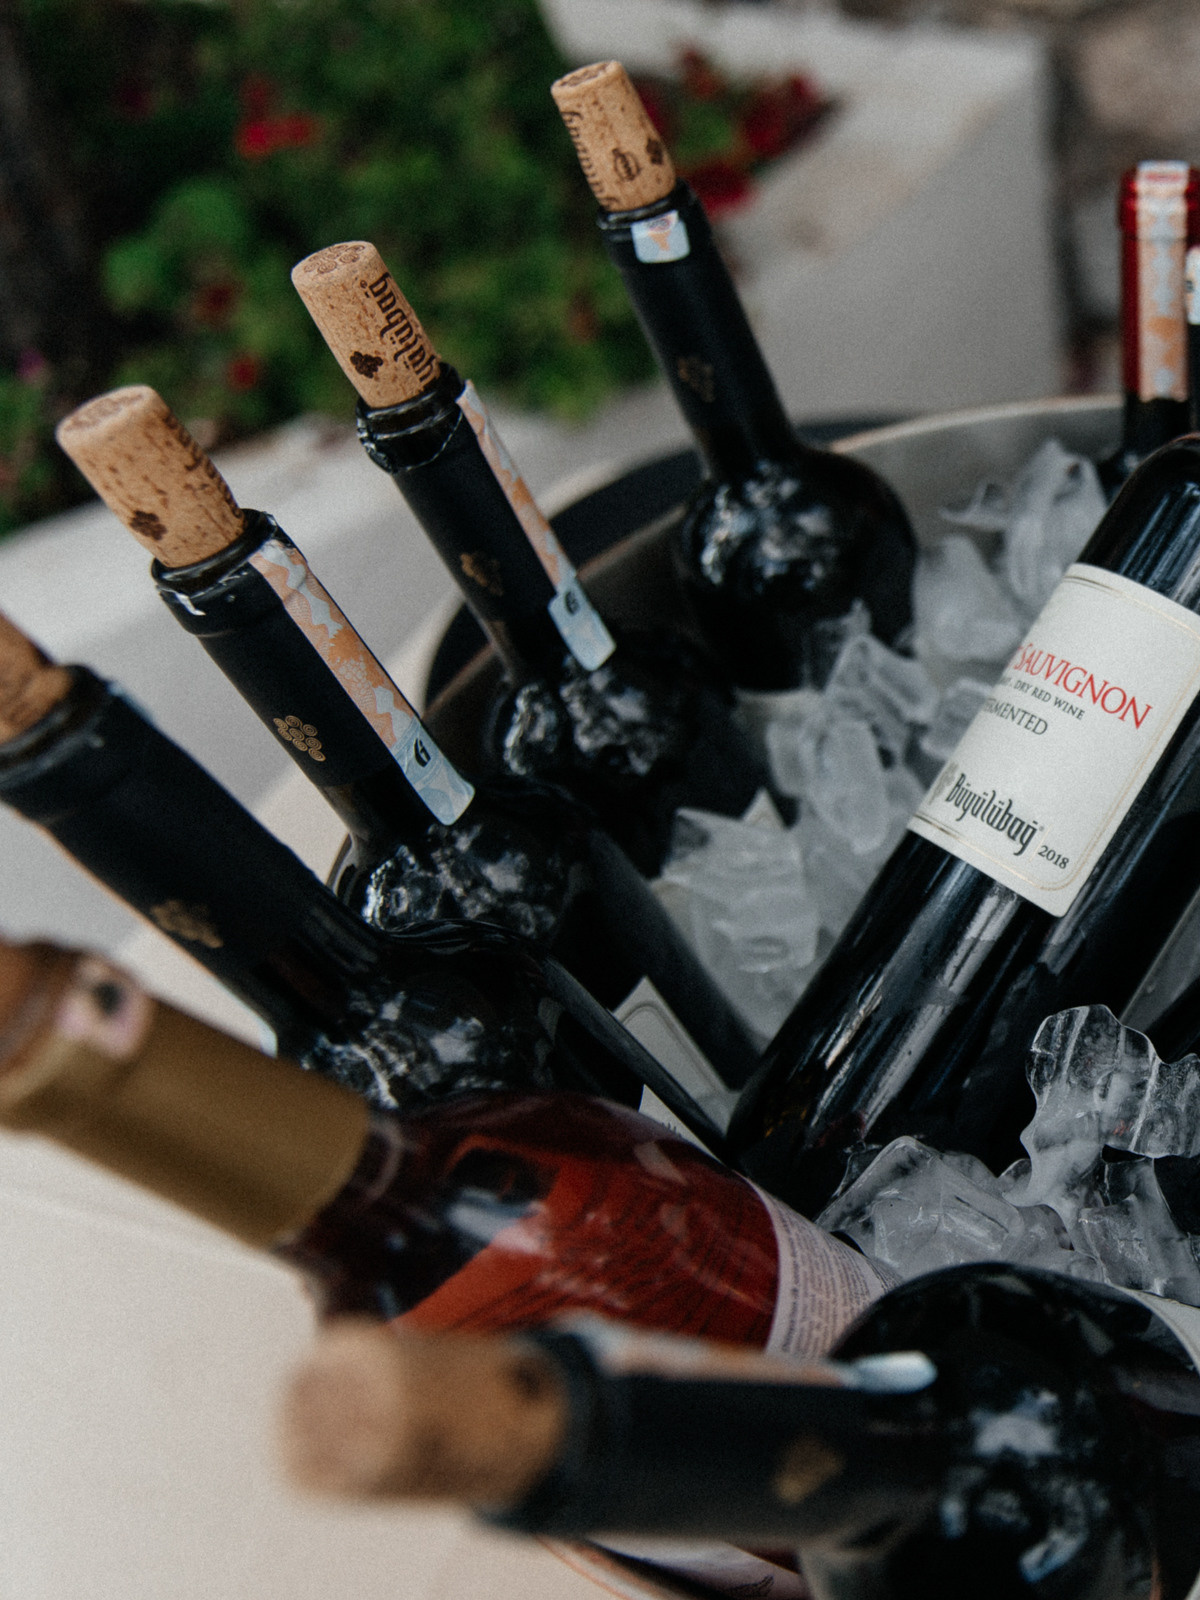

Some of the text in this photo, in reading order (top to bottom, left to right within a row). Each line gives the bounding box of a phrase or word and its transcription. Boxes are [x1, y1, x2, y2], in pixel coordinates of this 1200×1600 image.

[1013, 643, 1152, 730] SAUVIGNON
[1014, 680, 1032, 693] DRY
[1031, 687, 1052, 702] RED
[1053, 696, 1085, 720] WINE
[1037, 845, 1070, 869] 2018
